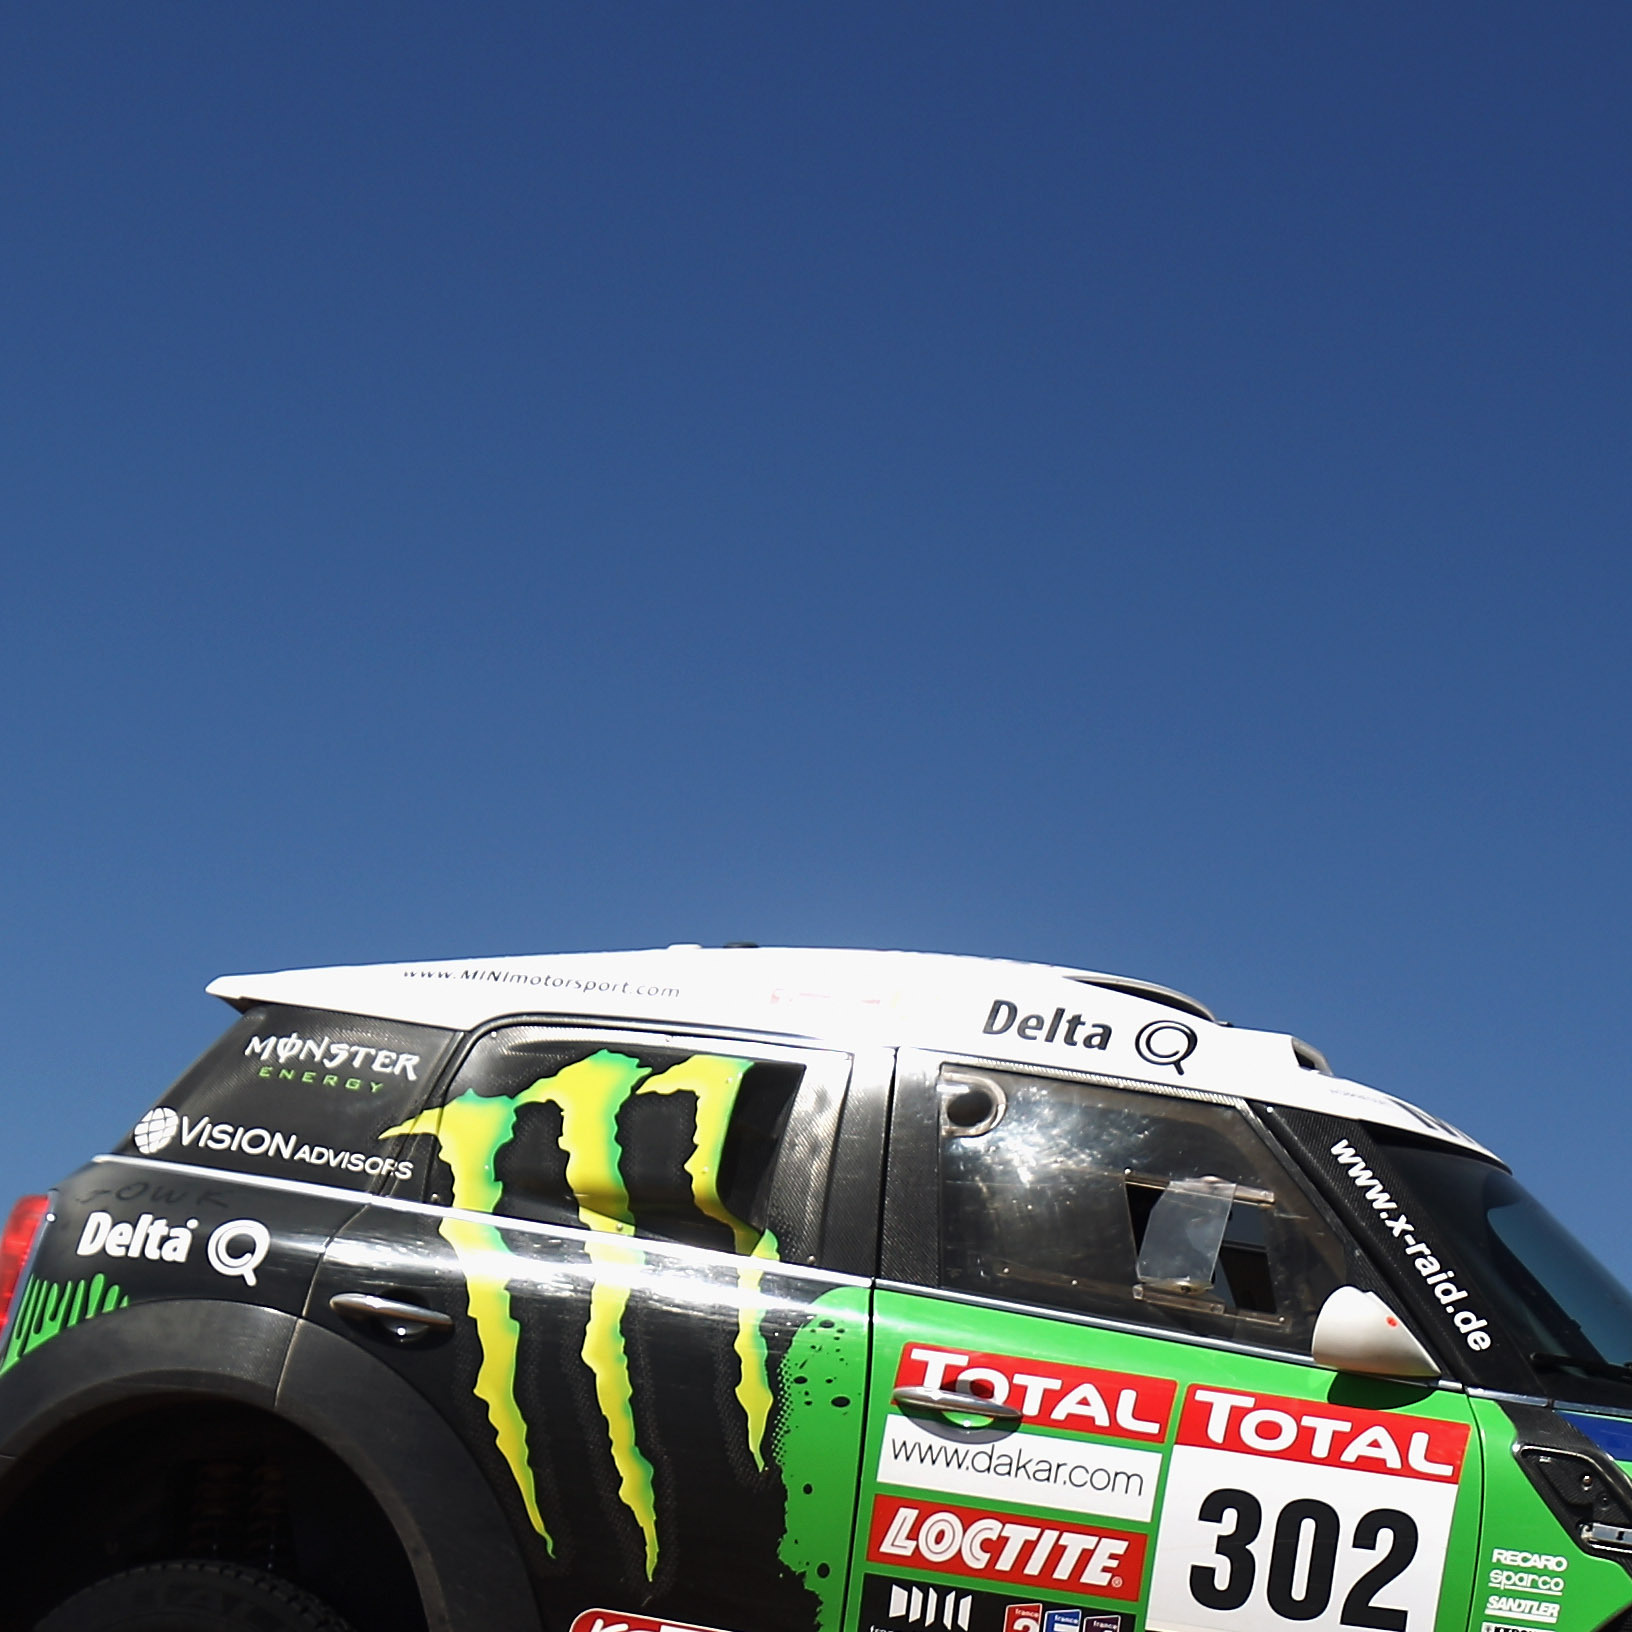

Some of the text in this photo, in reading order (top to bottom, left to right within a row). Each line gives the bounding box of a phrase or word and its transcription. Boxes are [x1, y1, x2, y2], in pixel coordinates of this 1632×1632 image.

[403, 968, 680, 999] www.MINImotorsport.com
[244, 1032, 421, 1081] MONSTER
[982, 998, 1198, 1076] Delta Q
[258, 1065, 385, 1093] ENERGY
[178, 1115, 414, 1180] VISION ADVISORS
[76, 1211, 270, 1287] Delta Q
[1330, 1138, 1492, 1352] www.x-raid.de
[1194, 1389, 1454, 1477] TOTAL
[891, 1437, 1145, 1498] www.dakar.com
[878, 1507, 1130, 1587] LOCTITE
[1188, 1487, 1420, 1632] 302
[1491, 1548, 1568, 1572] RECARO
[1486, 1595, 1560, 1617] SANDTLER
[1489, 1569, 1564, 1592] sparco
